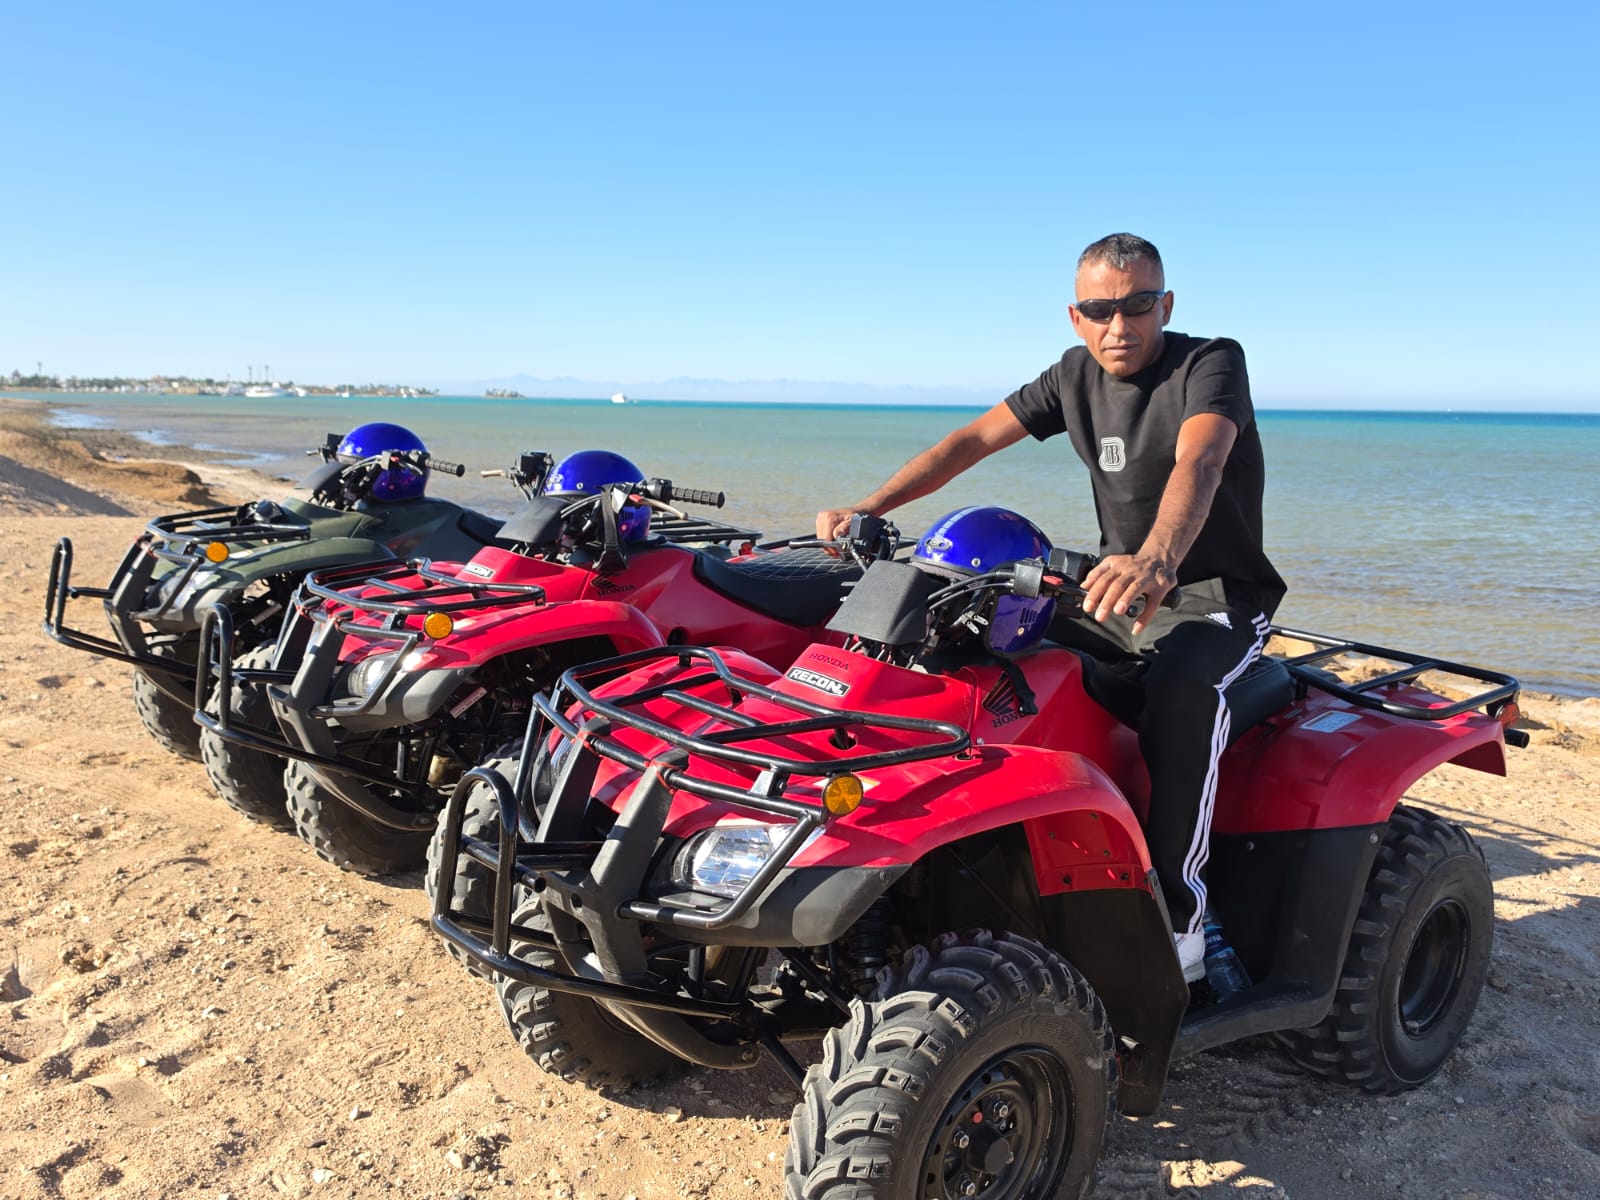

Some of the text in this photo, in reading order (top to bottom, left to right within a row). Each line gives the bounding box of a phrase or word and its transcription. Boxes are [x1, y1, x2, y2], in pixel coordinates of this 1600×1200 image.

[808, 652, 849, 671] HONDA
[789, 669, 844, 695] RECON
[991, 710, 1026, 728] HON
